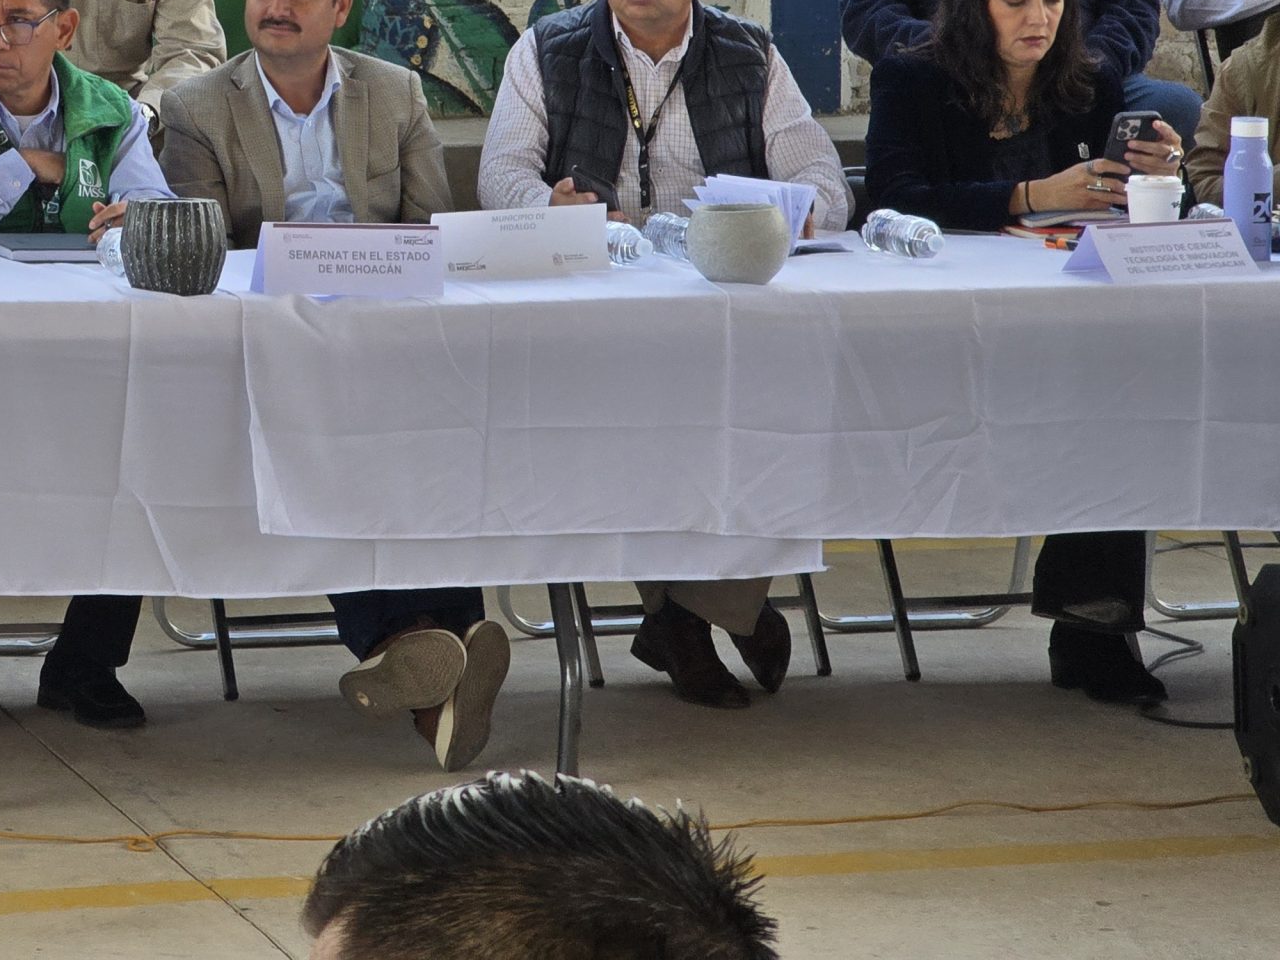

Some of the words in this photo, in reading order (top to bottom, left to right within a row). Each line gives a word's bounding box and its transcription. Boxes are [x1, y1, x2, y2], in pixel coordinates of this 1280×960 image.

[78, 184, 106, 198] IMSS
[288, 250, 349, 260] SEMARNAT
[351, 250, 367, 260] EN
[369, 251, 383, 261] EL
[386, 251, 431, 261] ESTADO
[318, 264, 333, 273] DE
